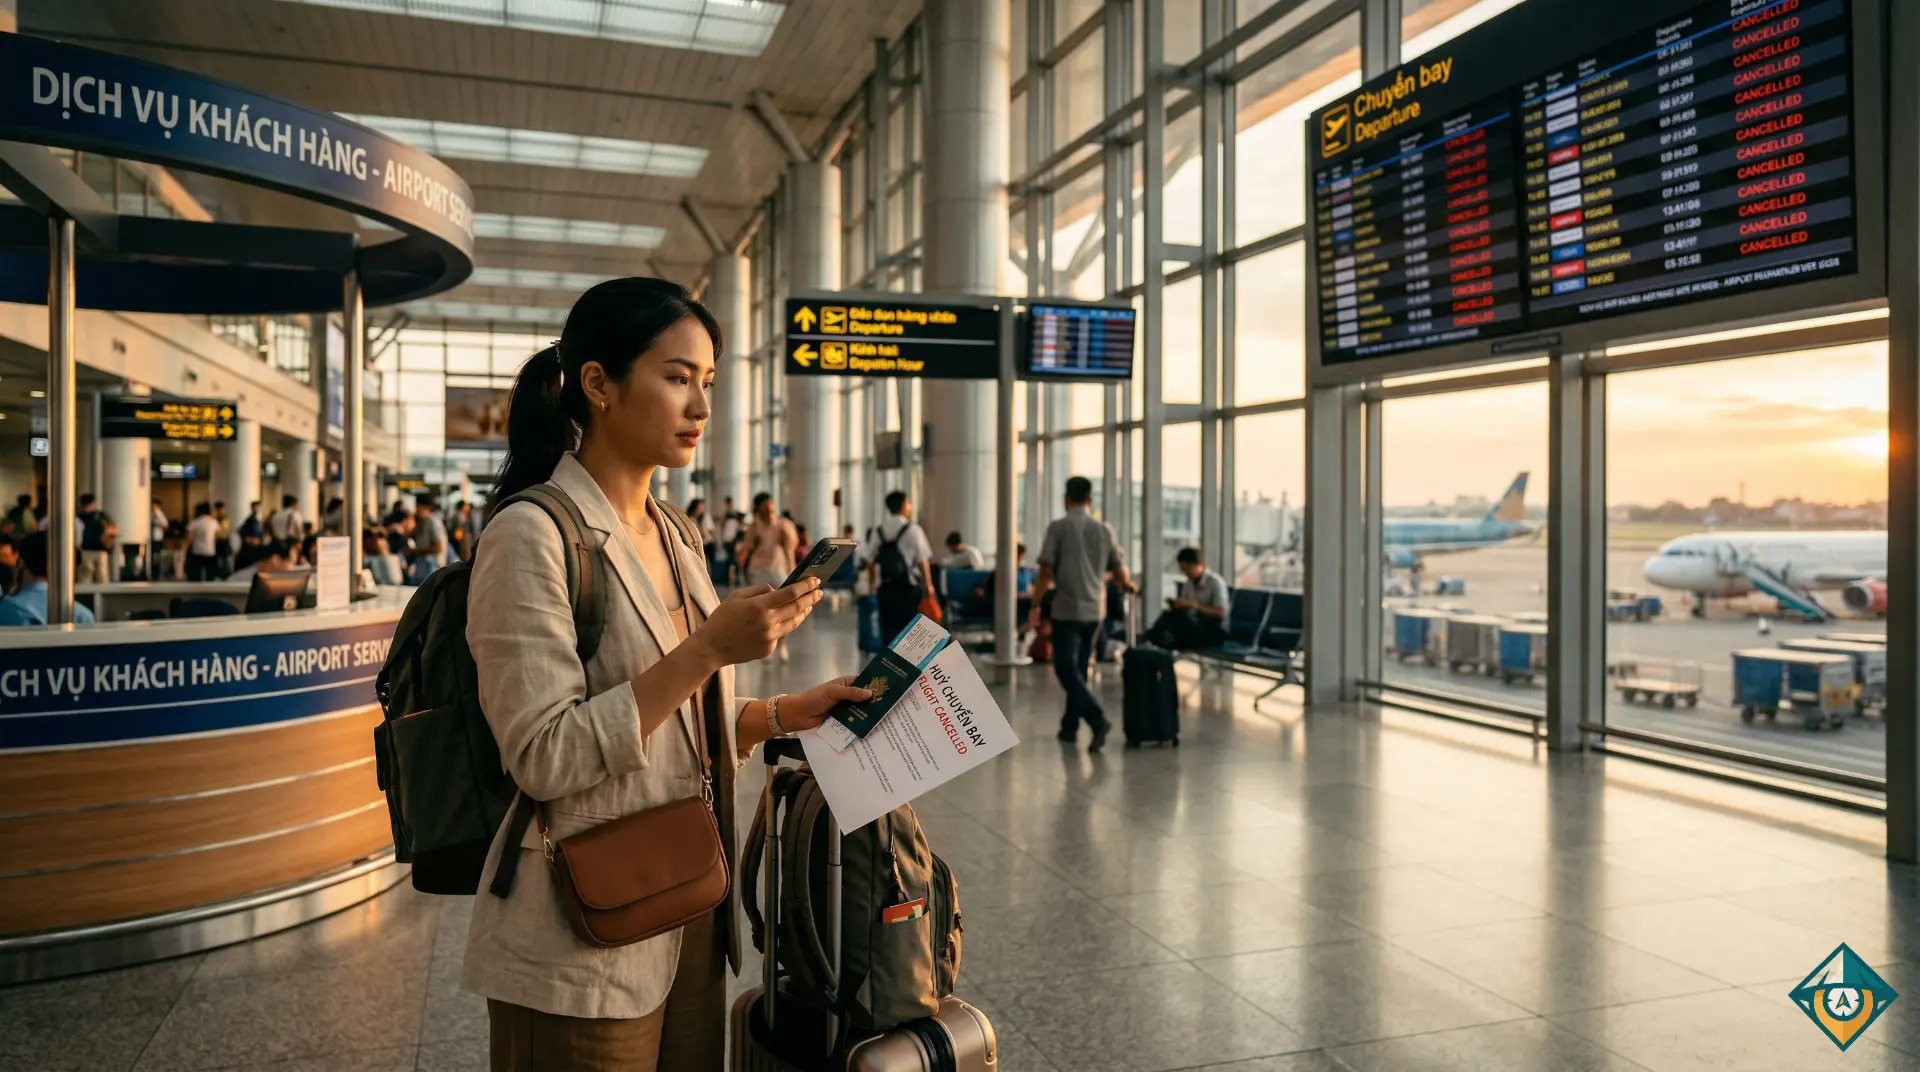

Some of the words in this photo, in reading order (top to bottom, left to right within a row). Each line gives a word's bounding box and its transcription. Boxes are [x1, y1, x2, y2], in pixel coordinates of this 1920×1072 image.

[1731, 0, 1799, 31] CANCELLED
[1732, 16, 1800, 49] CANCELLED
[1733, 36, 1800, 68] CANCELLED
[1420, 57, 1453, 88] bay
[1733, 55, 1801, 86] CANCELLED
[1734, 74, 1801, 104] CANCELLED
[1354, 101, 1421, 143] Departure
[1735, 93, 1802, 123] CANCELLED
[32, 66, 123, 120] DỊCH
[131, 85, 179, 139] VỤ
[189, 98, 292, 158] KHÁCH
[299, 128, 368, 181] HÀNG
[383, 159, 448, 216] AIRPORT
[1736, 113, 1803, 141] CANCELLED
[1736, 132, 1804, 160] CANCELLED
[1737, 152, 1805, 179] CANCELLED
[1738, 172, 1806, 198] CANCELLED
[1738, 192, 1807, 217] CANCELLED
[1739, 211, 1808, 235] CANCELLED
[1740, 231, 1808, 254] CANCELLED
[0, 669, 39, 699] CH
[46, 666, 86, 702] VỤ
[94, 657, 185, 693] KHÁCH
[191, 653, 258, 686] HÀNG
[274, 644, 351, 678] AIRPORT
[353, 638, 393, 667] SERV
[918, 675, 939, 705] FLIGHT
[934, 706, 968, 755] CANCELLED
[966, 726, 987, 747] BAY
